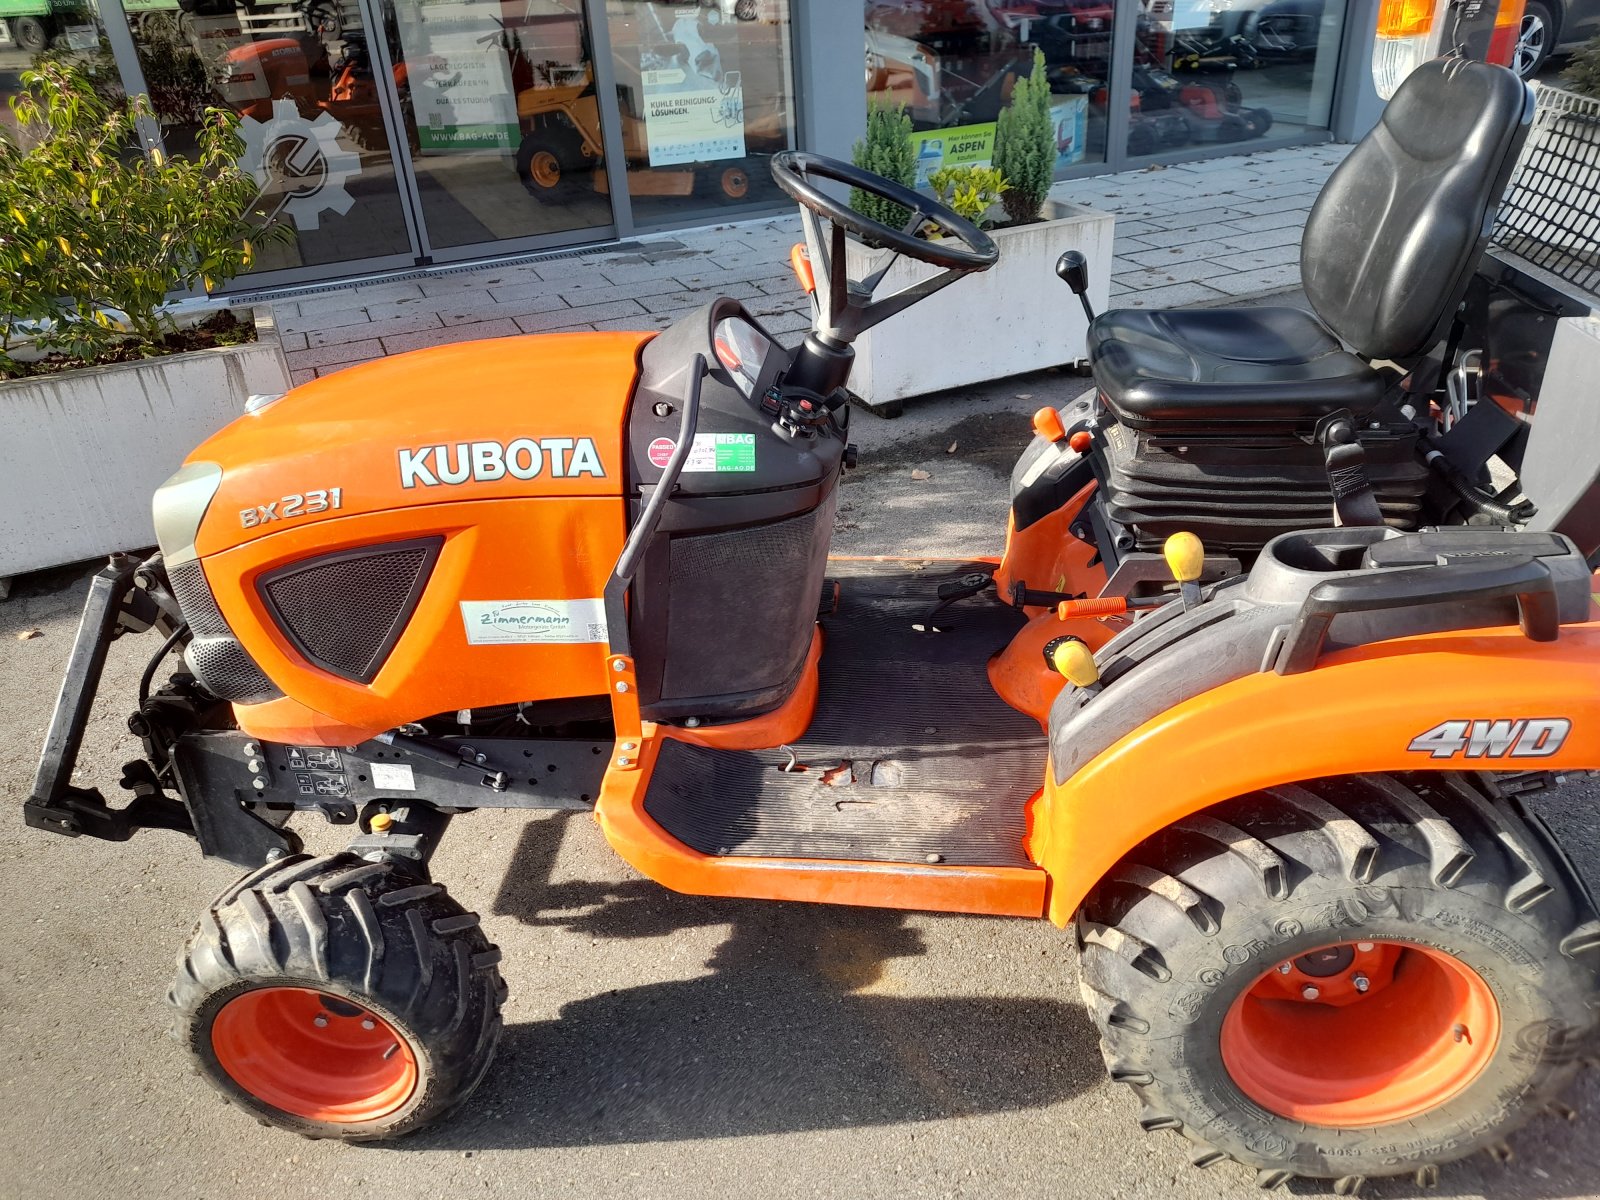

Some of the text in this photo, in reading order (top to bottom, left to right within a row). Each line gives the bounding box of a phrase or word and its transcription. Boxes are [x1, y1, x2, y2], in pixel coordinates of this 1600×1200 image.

[674, 96, 718, 107] REINIGUNGS-
[430, 131, 510, 142] WWW.BAG-AO.DE
[949, 139, 986, 155] ASPEN
[726, 433, 754, 445] BAG
[397, 437, 607, 489] KUBOTA
[239, 487, 343, 530] BX231
[480, 611, 570, 626] Zimmermann
[1406, 717, 1573, 759] 4WD
